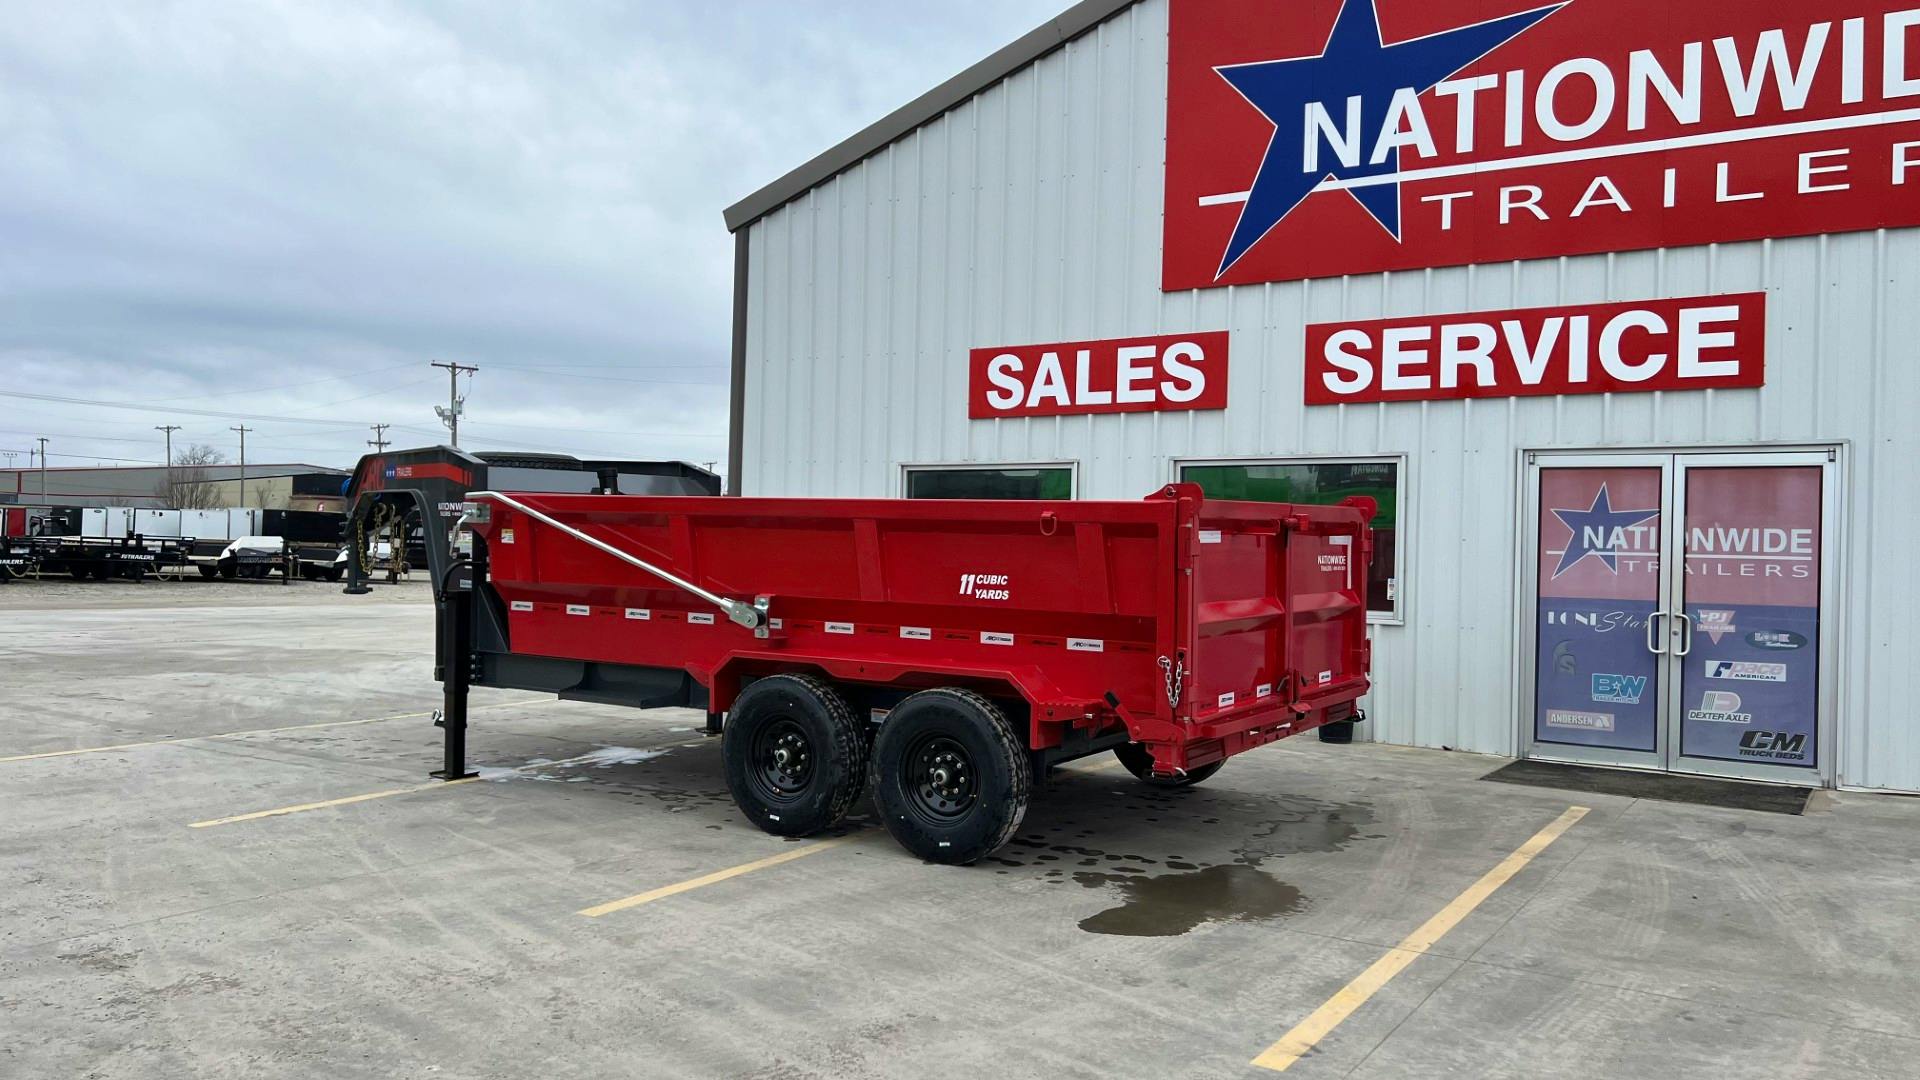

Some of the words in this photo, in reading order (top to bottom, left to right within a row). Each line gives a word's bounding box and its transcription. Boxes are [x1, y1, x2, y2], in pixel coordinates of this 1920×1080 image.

[1322, 305, 1740, 394] SERVICE
[986, 342, 1206, 410] SALES
[1583, 525, 1813, 554] NATINWIDE
[959, 574, 976, 595] 11
[976, 574, 1008, 585] CUBIC
[975, 589, 1010, 600] YARDS
[1707, 612, 1728, 623] PJ
[1734, 673, 1777, 681] AMERICAN
[1551, 713, 1593, 726] ANDERSEN
[1689, 711, 1725, 721] DEXTER
[1725, 713, 1750, 723] AXLE
[1739, 730, 1808, 753] CM
[1739, 749, 1774, 758] TRUCK
[1775, 752, 1806, 761] BEDS
